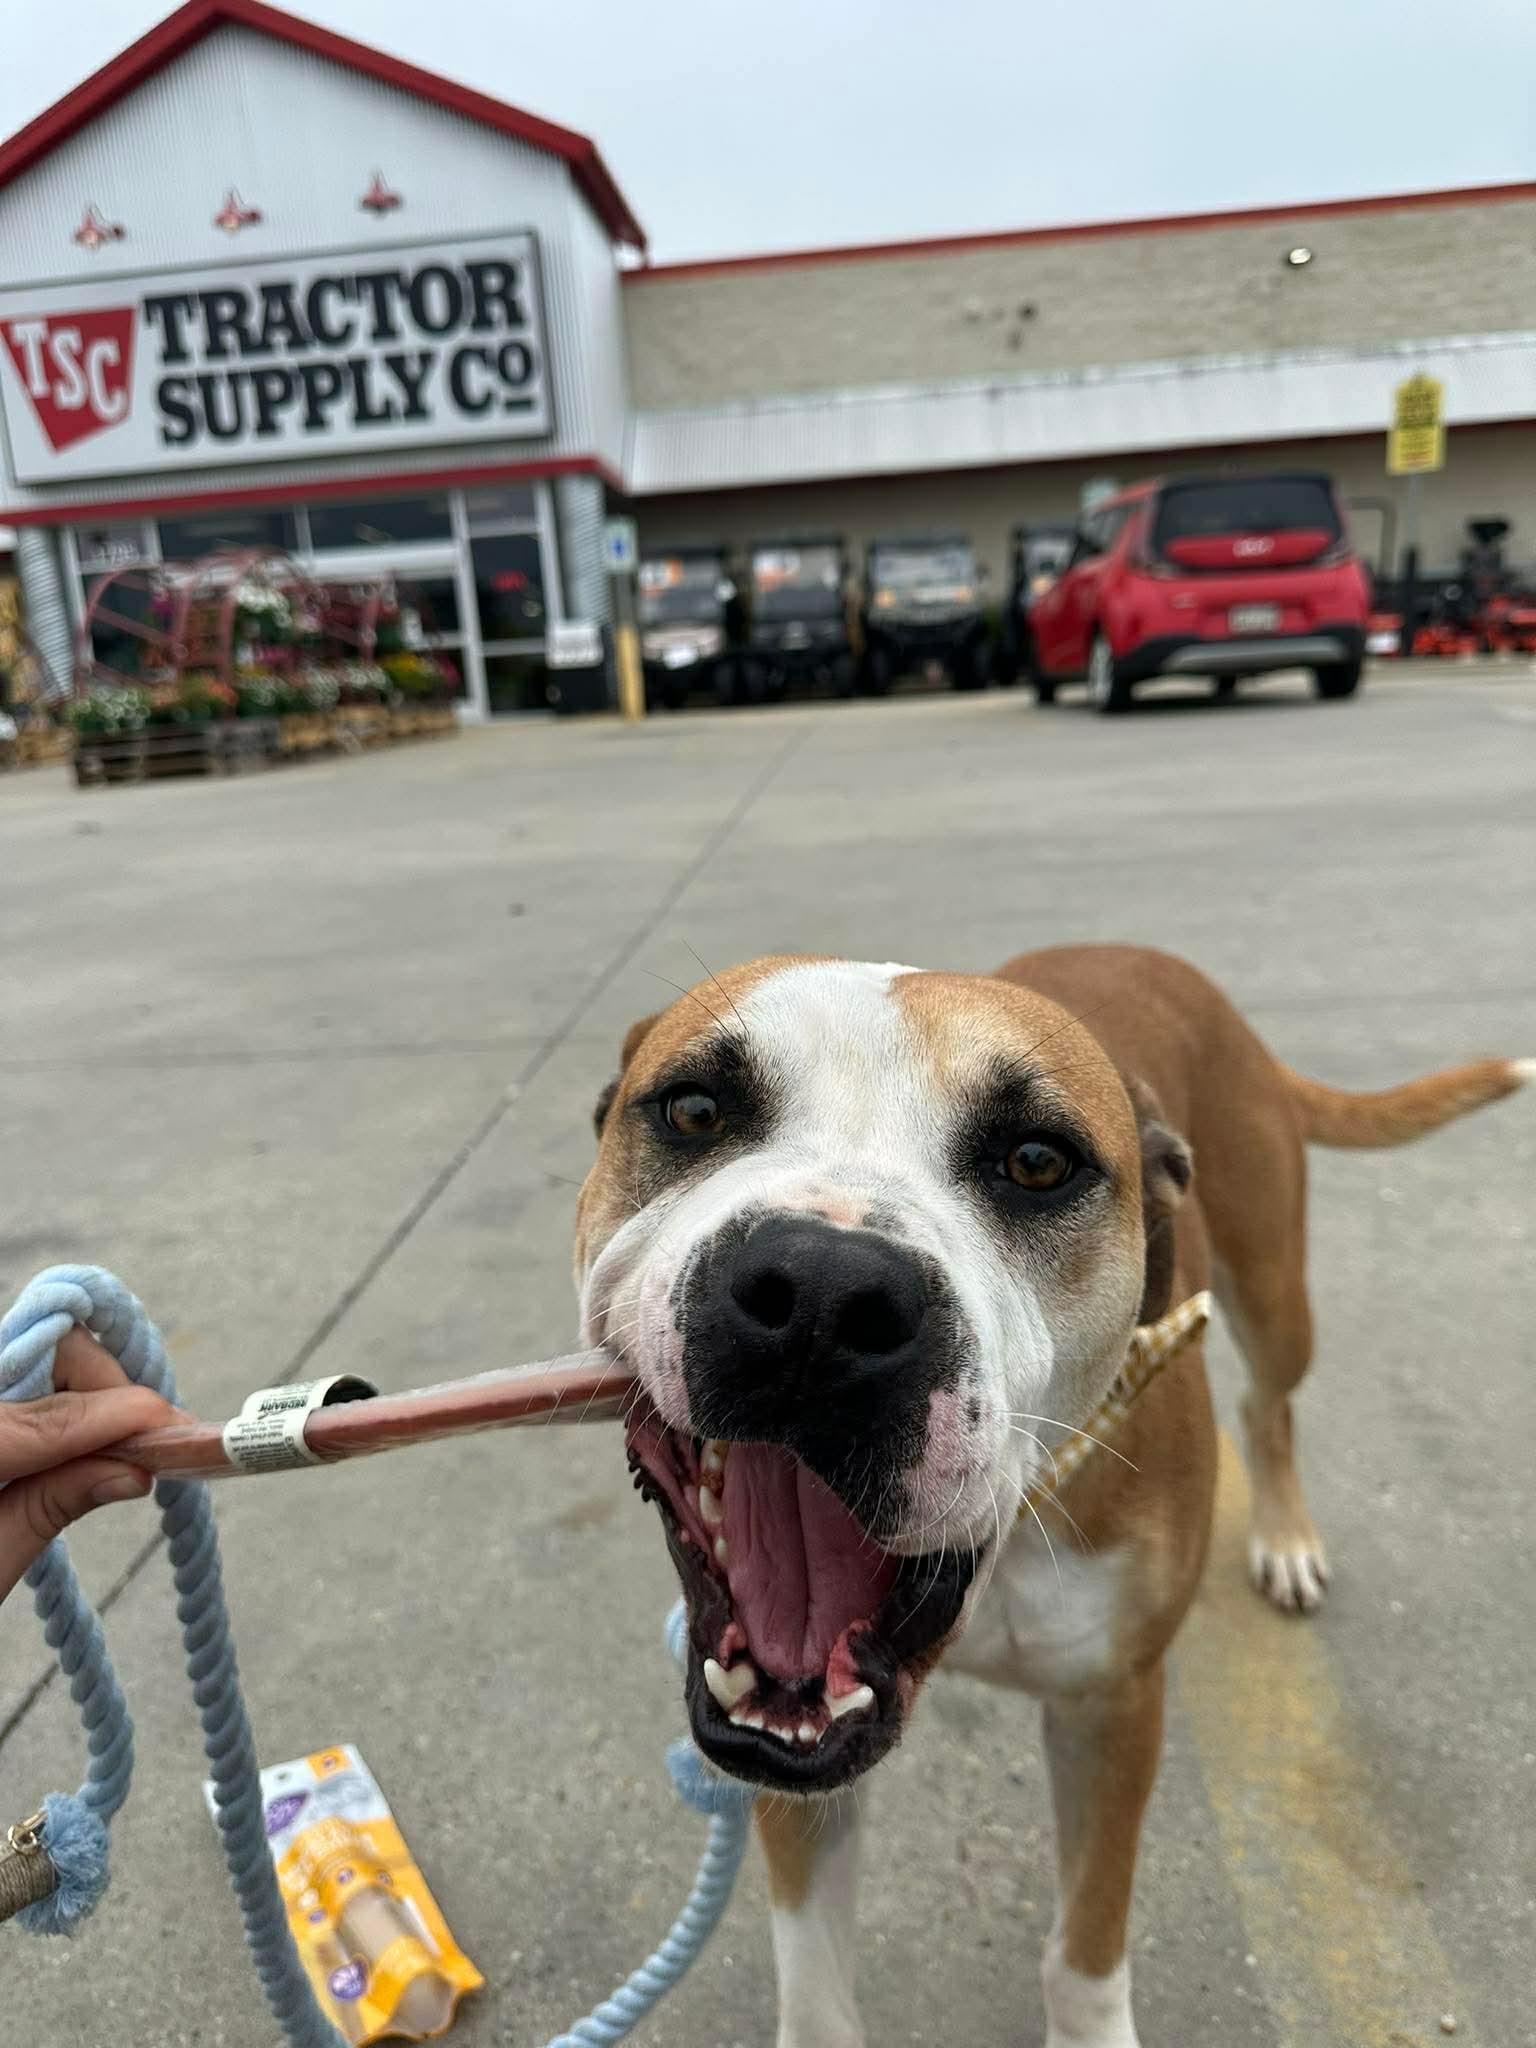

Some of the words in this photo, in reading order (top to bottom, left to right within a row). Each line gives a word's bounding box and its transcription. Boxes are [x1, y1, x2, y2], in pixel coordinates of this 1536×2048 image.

[142, 260, 525, 365] TRACTOR
[10, 321, 128, 424] TSC
[156, 351, 433, 446] SUPPLY
